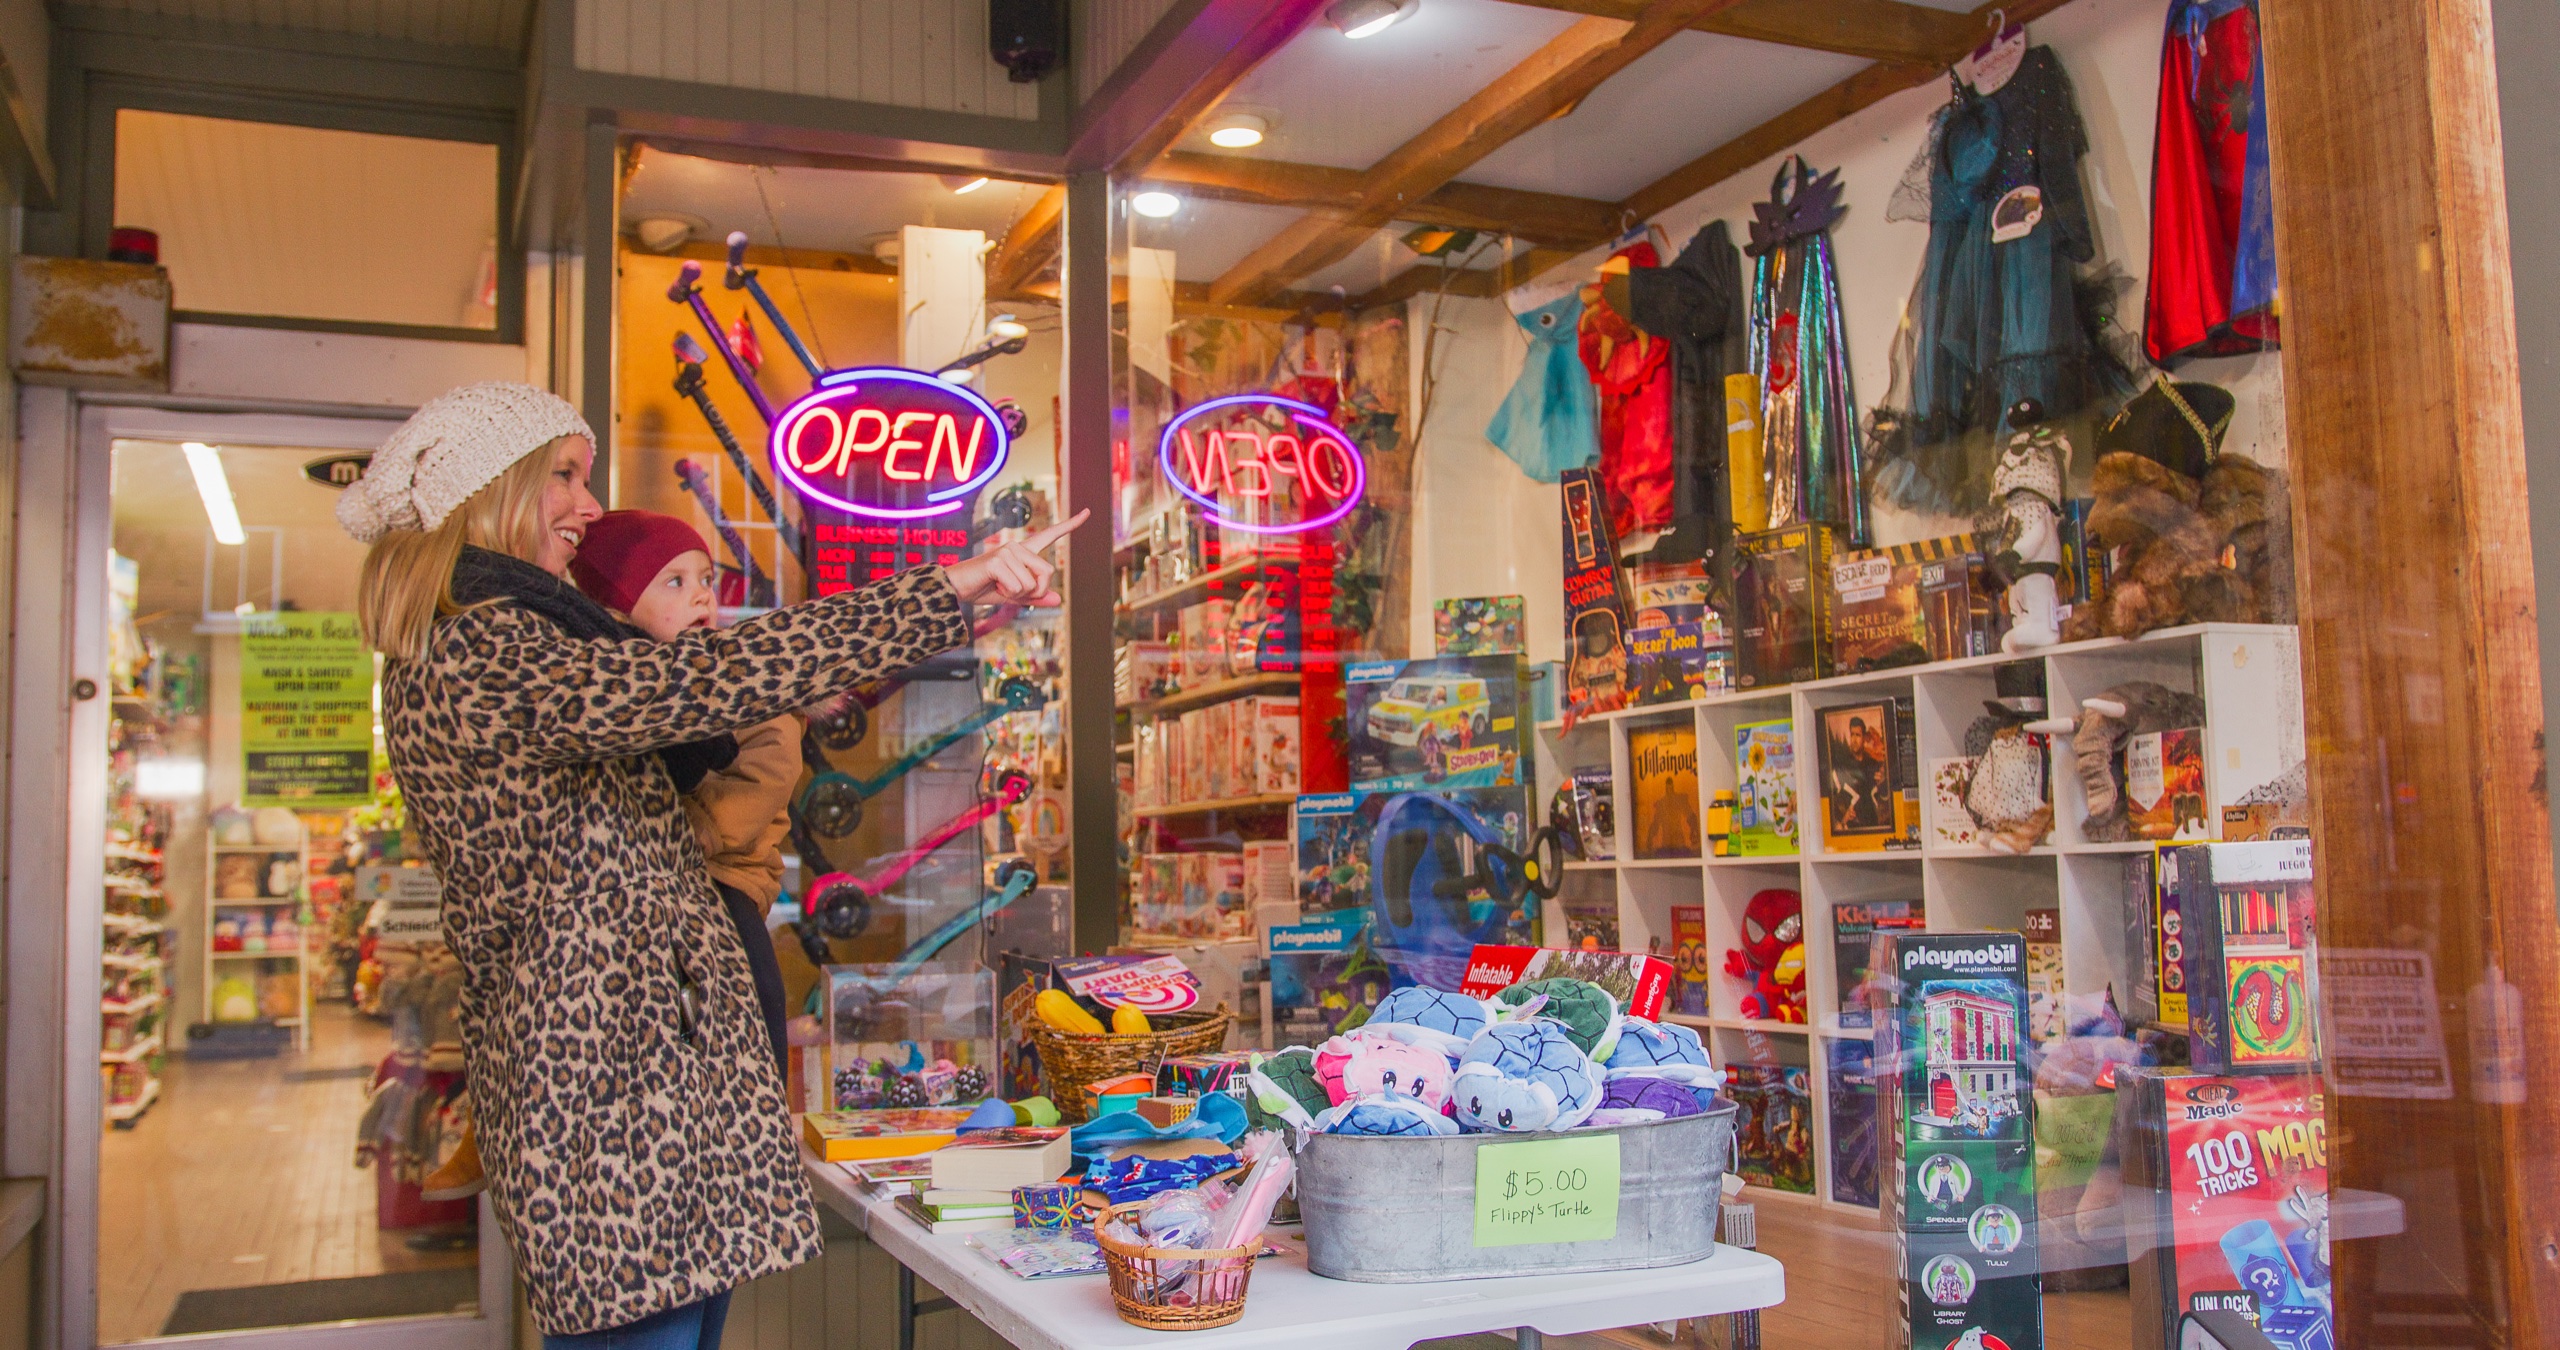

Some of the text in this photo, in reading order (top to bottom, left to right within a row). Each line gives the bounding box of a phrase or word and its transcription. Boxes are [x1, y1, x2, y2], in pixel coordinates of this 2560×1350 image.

[787, 406, 985, 482] OPEN
[816, 524, 968, 548] BUSINESS HOURS
[817, 548, 856, 563] MON
[816, 565, 847, 580] TUE
[1564, 566, 1612, 592] COWBOY
[1923, 565, 1945, 586] EXIT
[1841, 612, 1888, 630] SECRET
[1660, 628, 1676, 639] THE
[1633, 635, 1698, 655] SECRET DOOR
[1348, 665, 1395, 680] playmobil
[1637, 745, 1698, 782] Villainous
[1298, 796, 1354, 812] playmobil
[2279, 860, 2306, 871] JUEGO
[1273, 929, 1342, 948] playmobil
[1904, 944, 2017, 970] playmobil
[1468, 962, 1514, 986] Inflatable
[1954, 966, 2017, 974] www.playmobil.com
[1084, 970, 1138, 990] DART
[2201, 1086, 2224, 1101] IDEAL
[2186, 1102, 2243, 1120] Magic
[2186, 1118, 2326, 1179] 100 MAG
[1502, 1168, 1587, 1200] $5.00
[2196, 1167, 2258, 1198] TRICKS
[1491, 1200, 1592, 1224] Flippy's Turtle
[1926, 1216, 1968, 1224] SPENGLER
[1934, 1310, 1966, 1318] LIBRARY
